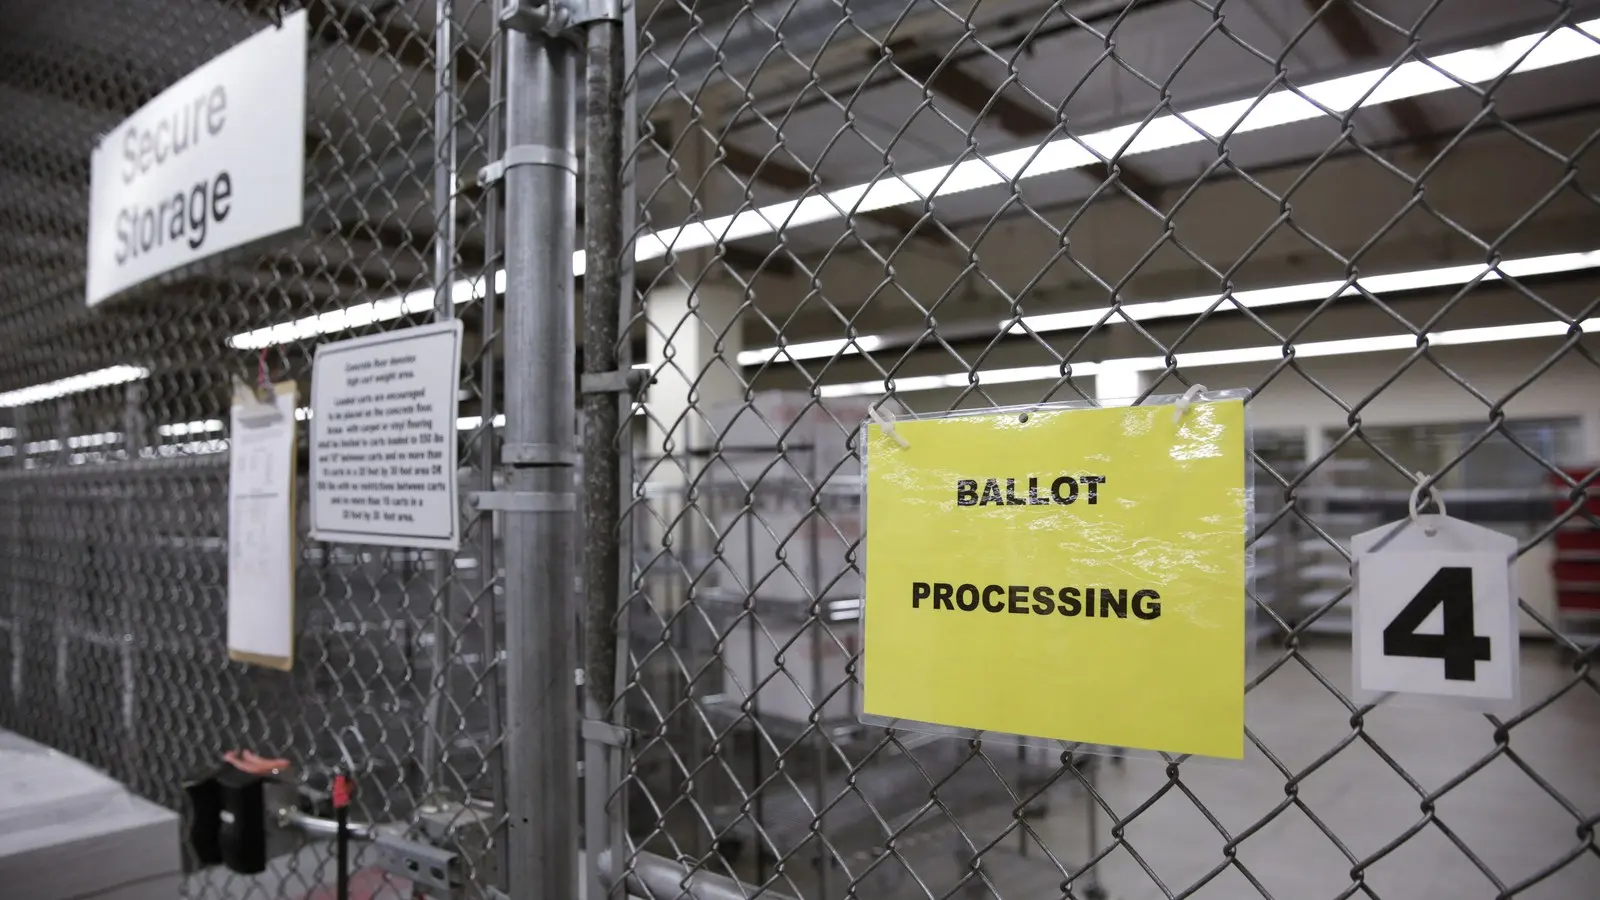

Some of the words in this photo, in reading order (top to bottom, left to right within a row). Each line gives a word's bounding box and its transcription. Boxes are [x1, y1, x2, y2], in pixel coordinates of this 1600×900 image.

[122, 84, 227, 185] Secure
[115, 171, 232, 265] Storage
[386, 387, 425, 400] encouraged
[397, 481, 425, 491] between
[427, 481, 445, 491] carts
[957, 475, 1106, 507] BALLOT
[912, 582, 1161, 620] PROCESSING
[1383, 567, 1491, 681] 4
